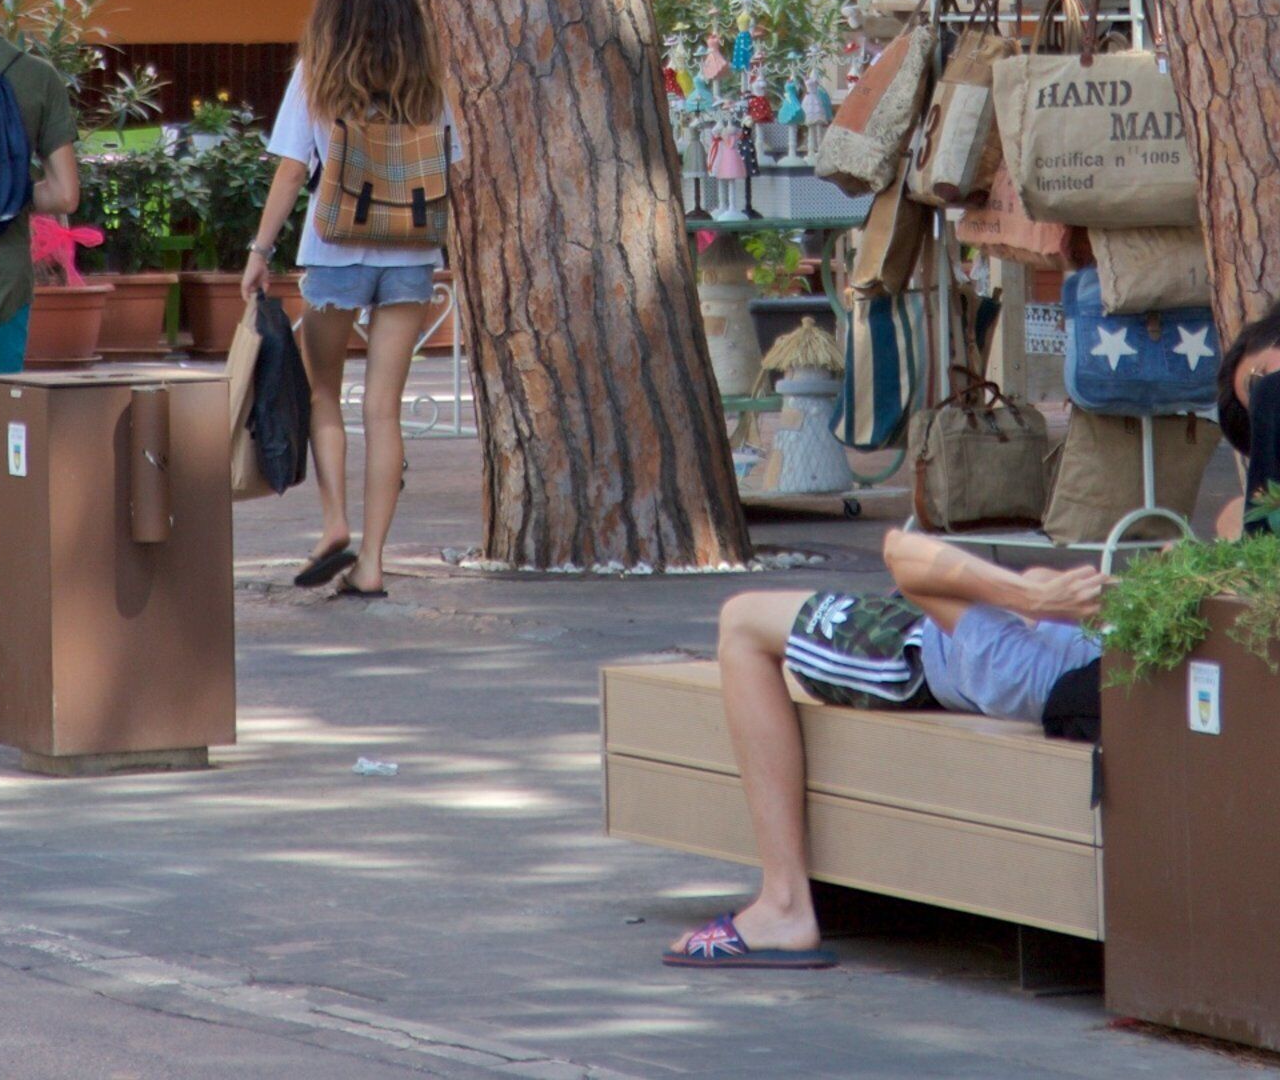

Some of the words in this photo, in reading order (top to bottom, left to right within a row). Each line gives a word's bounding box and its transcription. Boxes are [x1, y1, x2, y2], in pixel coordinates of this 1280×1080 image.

[1035, 80, 1132, 110] HAND
[1140, 150, 1181, 166] 1005
[1035, 174, 1094, 192] limited
